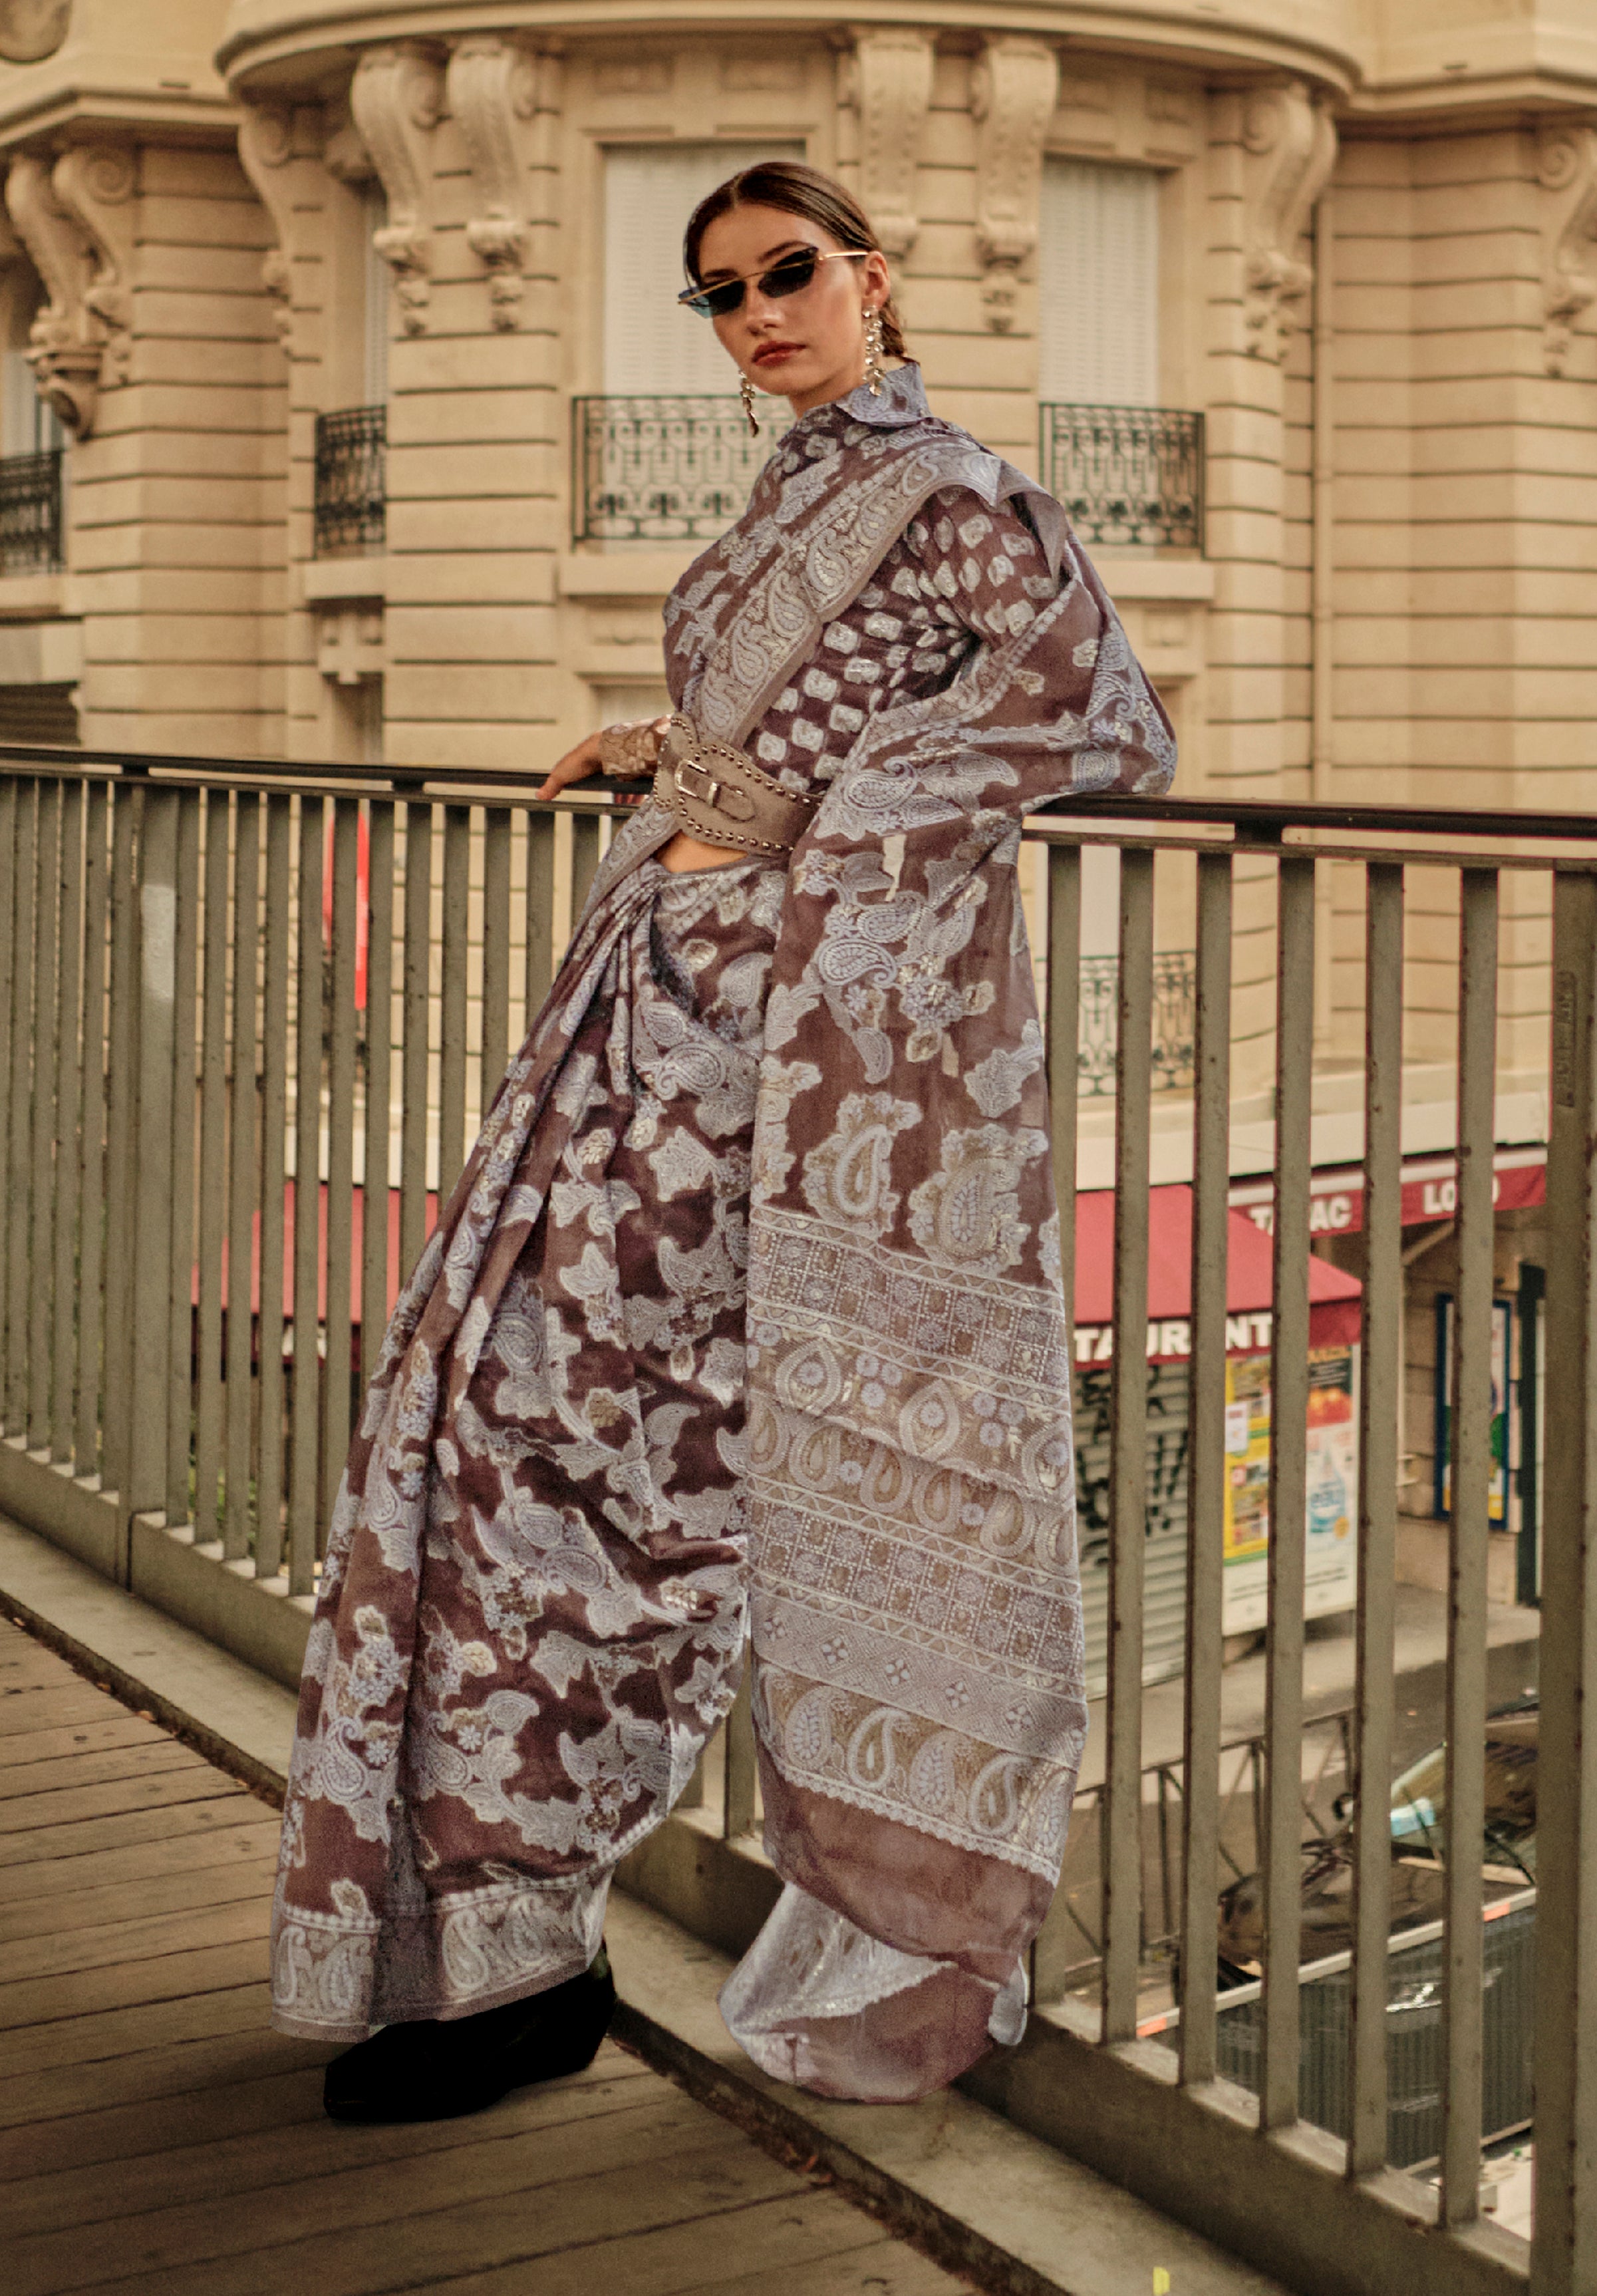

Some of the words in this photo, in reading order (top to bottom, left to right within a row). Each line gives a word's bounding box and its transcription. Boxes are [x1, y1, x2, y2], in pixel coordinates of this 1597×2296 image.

[1248, 1196, 1353, 1236] TAC
[1422, 1175, 1501, 1215] LO
[1073, 1311, 1273, 1363] TARNT
